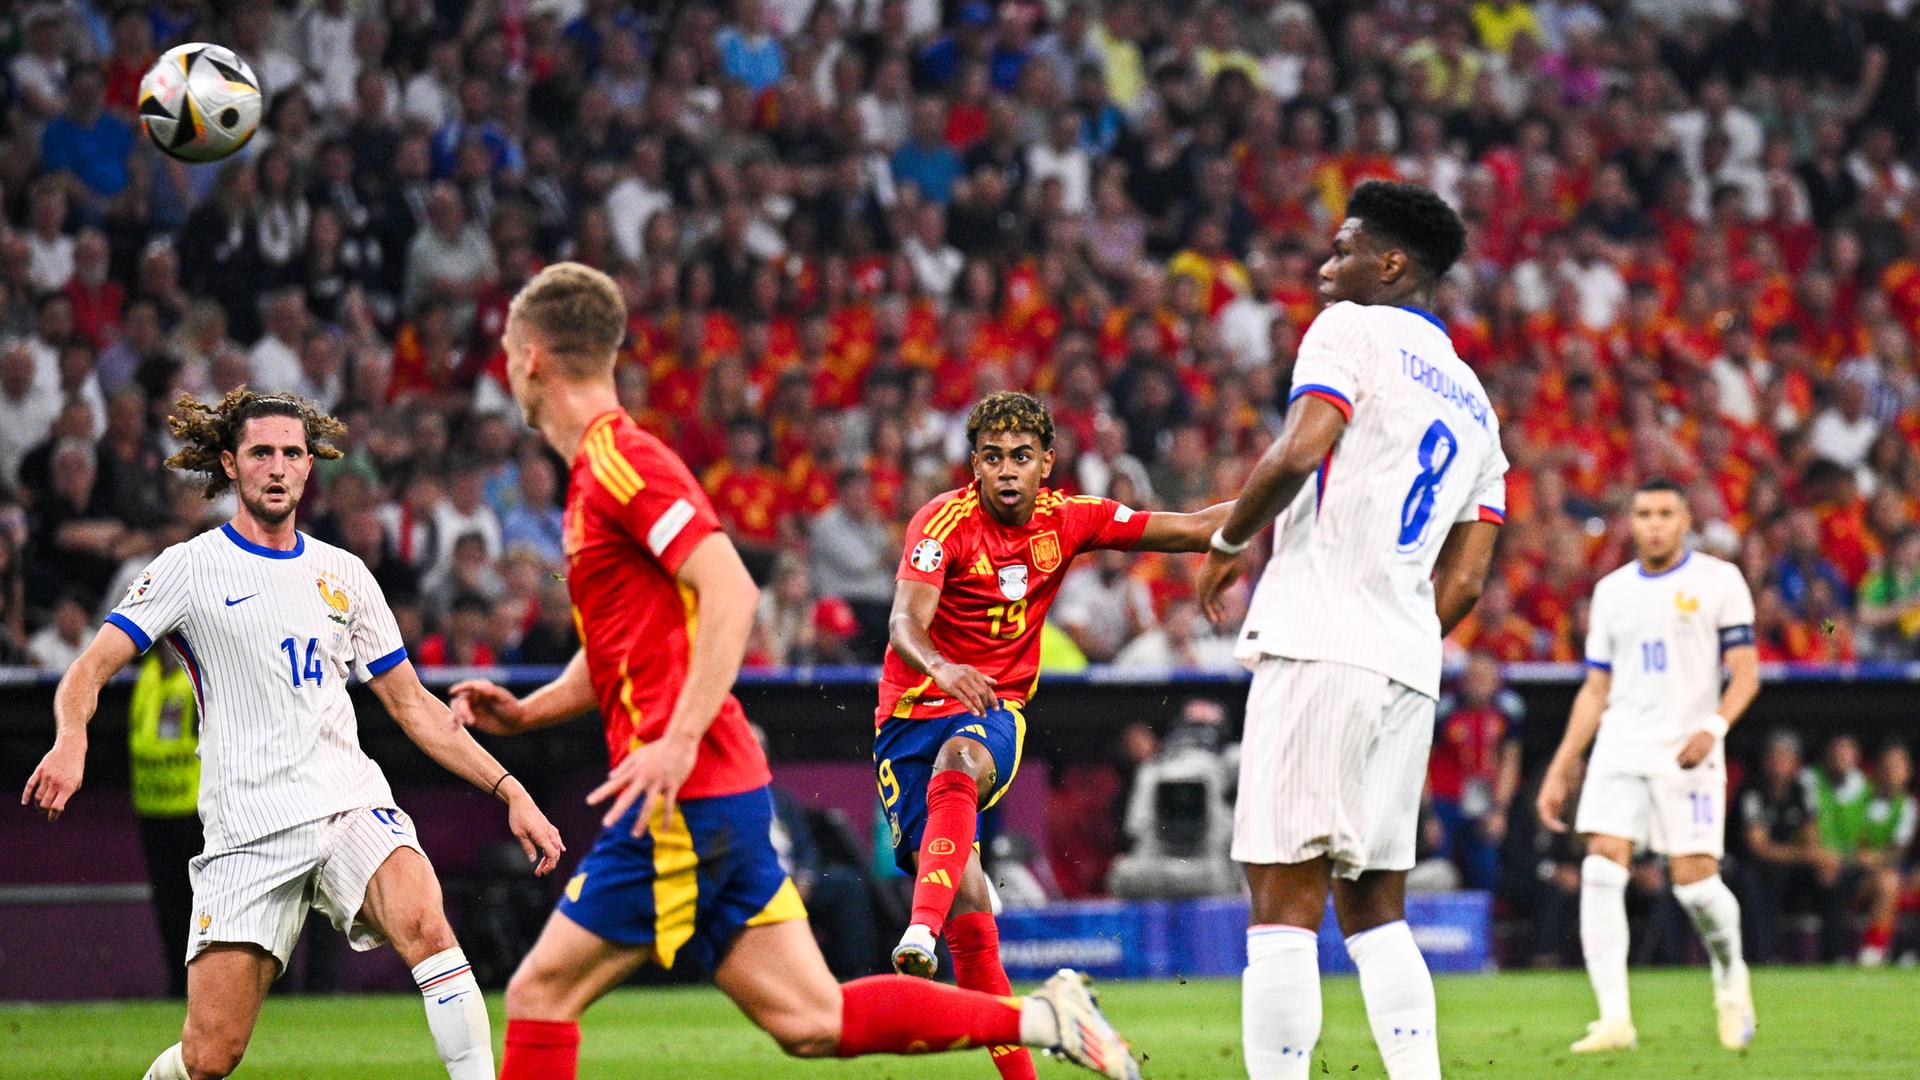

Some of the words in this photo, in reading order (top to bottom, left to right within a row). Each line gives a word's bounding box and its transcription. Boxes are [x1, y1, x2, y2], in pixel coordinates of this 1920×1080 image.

[1397, 418, 1458, 553] 8
[986, 598, 1028, 640] 19
[280, 636, 323, 689] 14
[1641, 639, 1667, 673] 10
